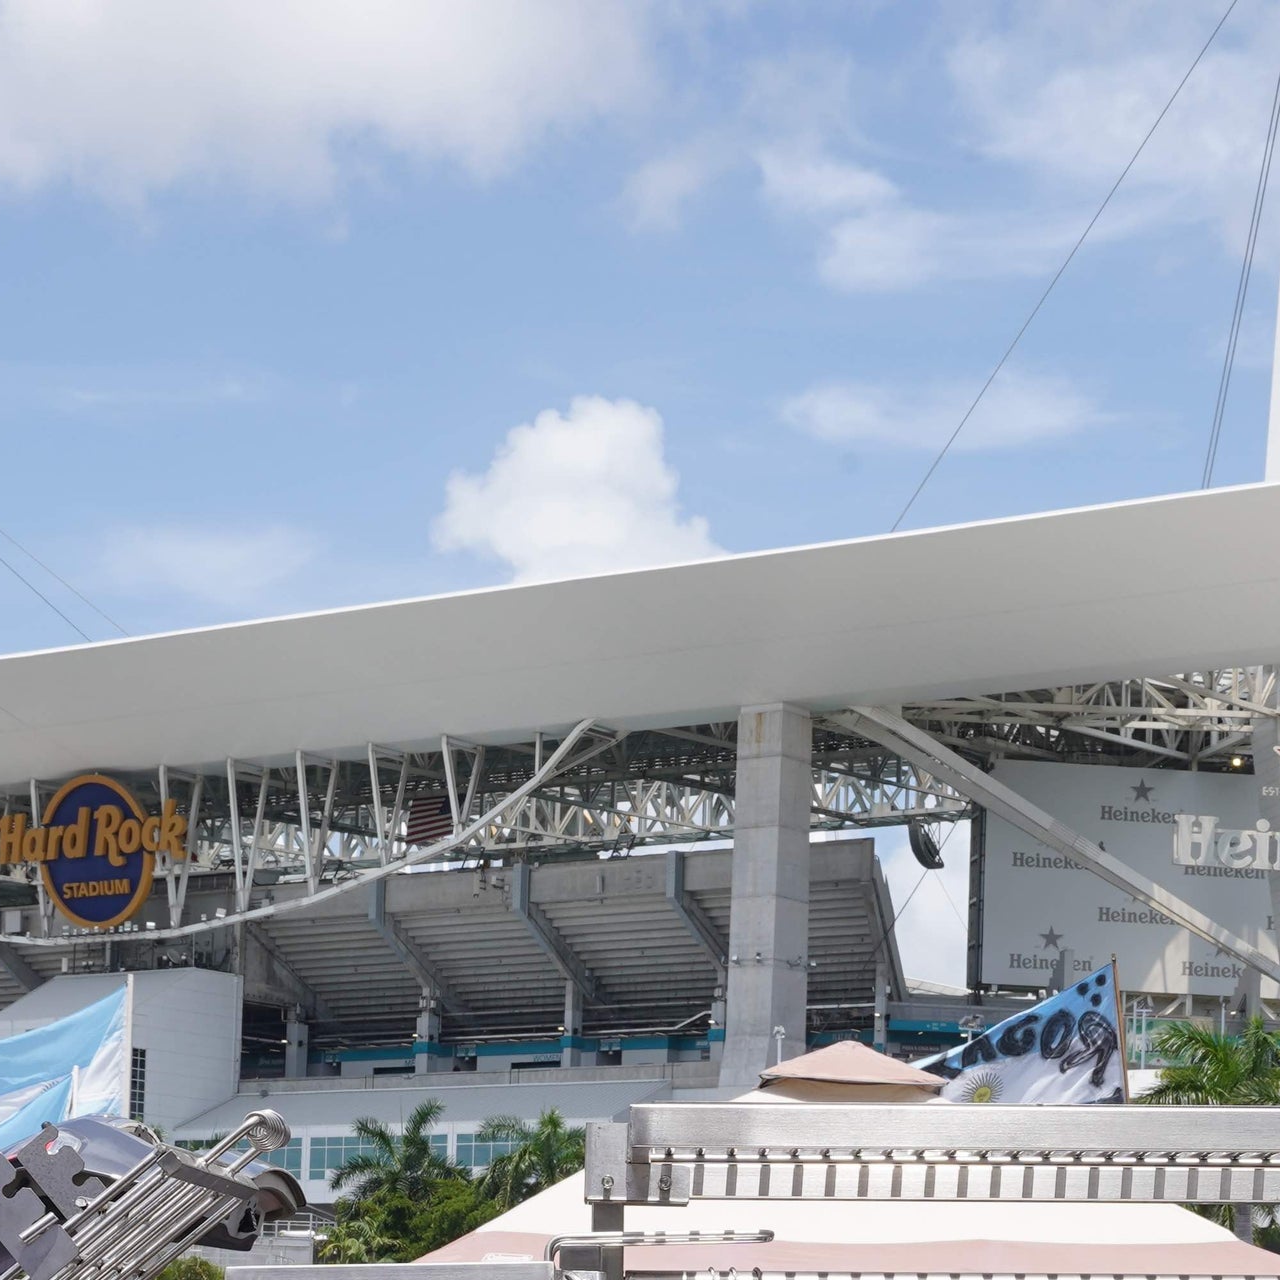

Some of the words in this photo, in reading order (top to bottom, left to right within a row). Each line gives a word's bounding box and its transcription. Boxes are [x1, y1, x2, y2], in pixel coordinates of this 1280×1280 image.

[93, 799, 188, 867] Rock
[62, 878, 131, 899] STADIUM
[1008, 953, 1092, 972] Heineen
